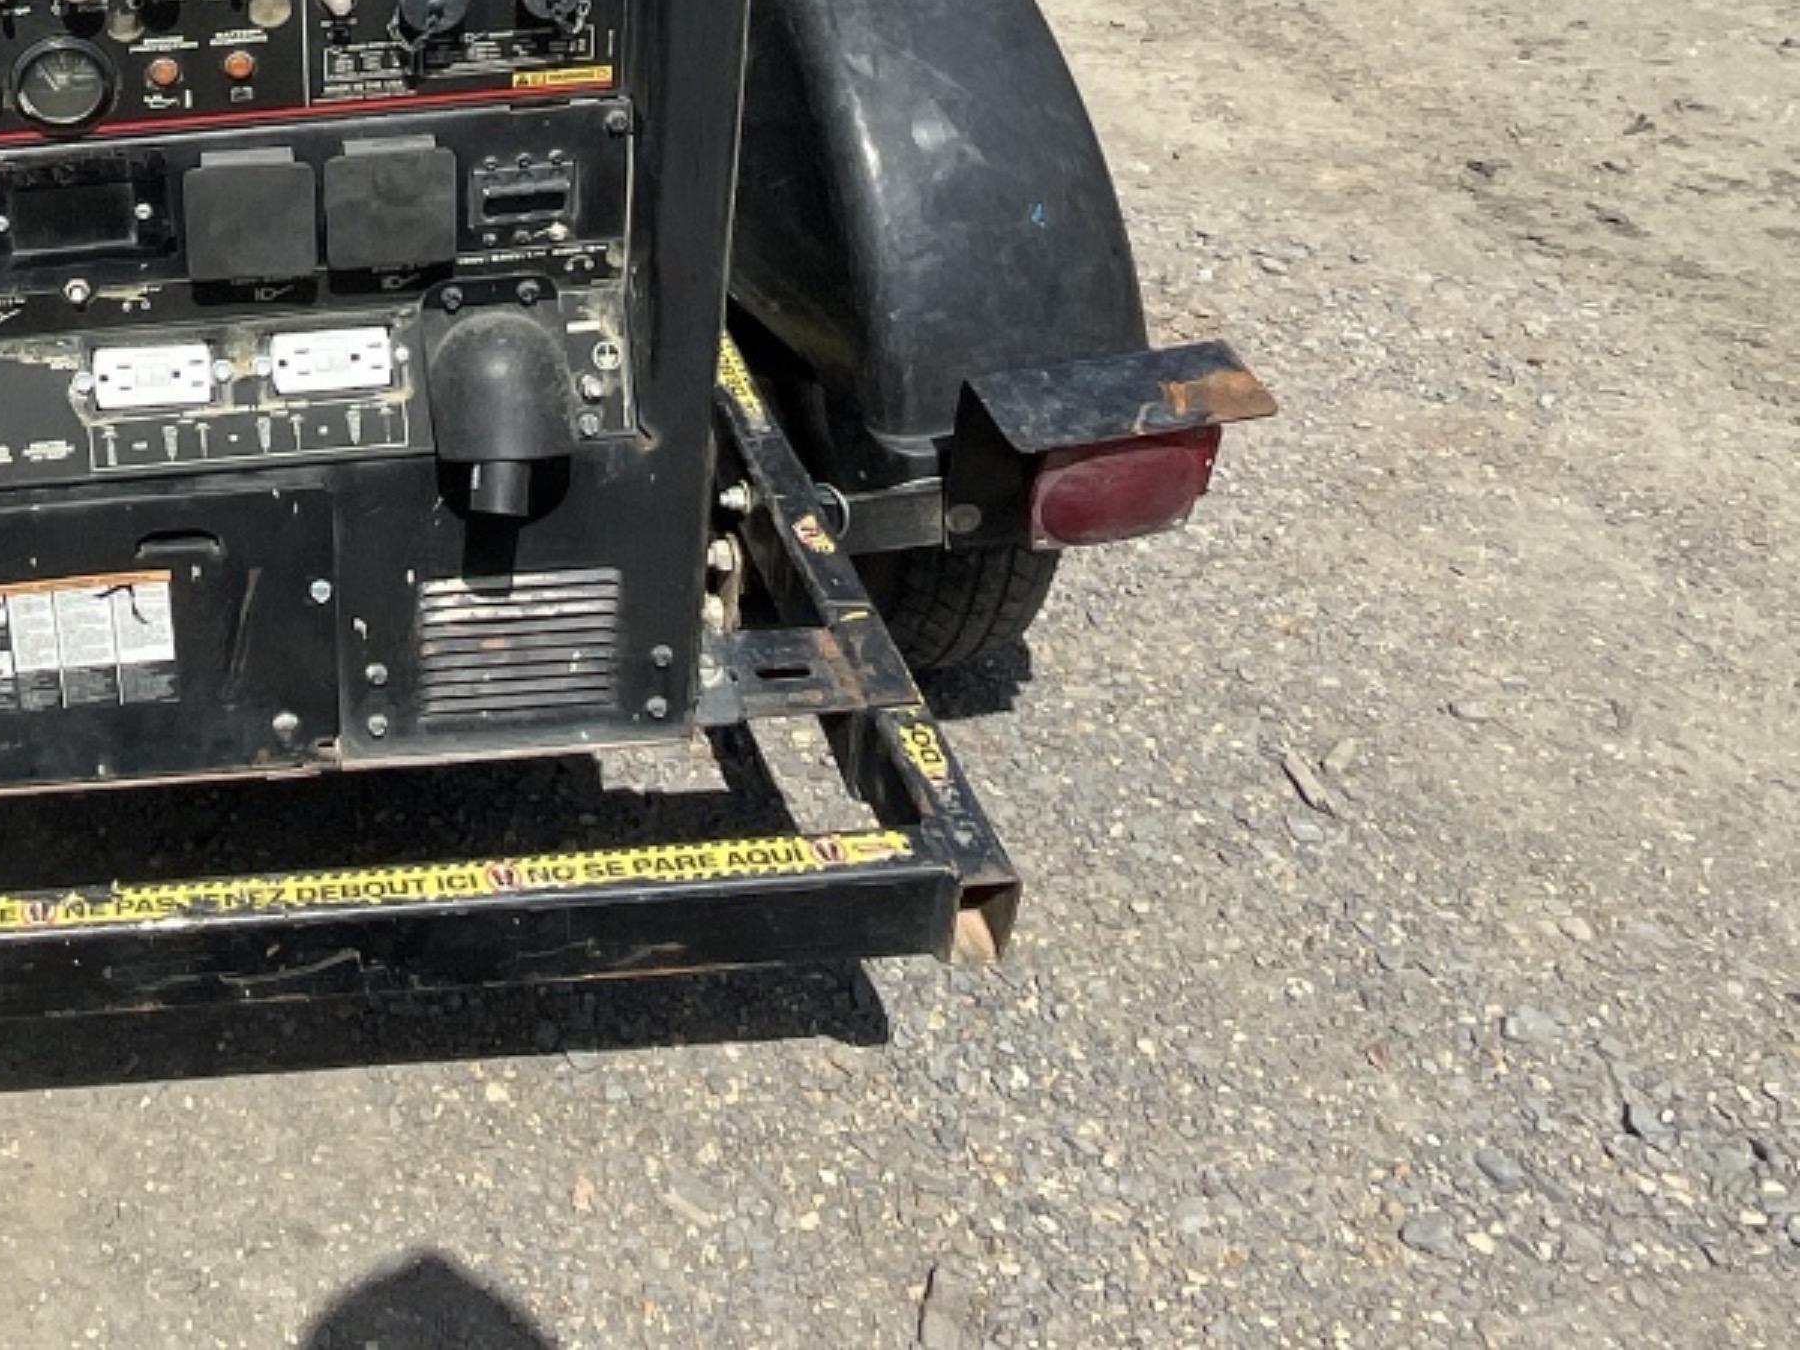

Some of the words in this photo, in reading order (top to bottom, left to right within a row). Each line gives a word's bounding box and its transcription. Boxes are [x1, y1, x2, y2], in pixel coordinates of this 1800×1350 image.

[528, 863, 577, 884] NO
[584, 860, 628, 880] SE
[633, 851, 720, 875] PARE
[728, 846, 806, 869] AQUI
[296, 878, 424, 904] DEBOUT
[438, 872, 477, 891] ICI
